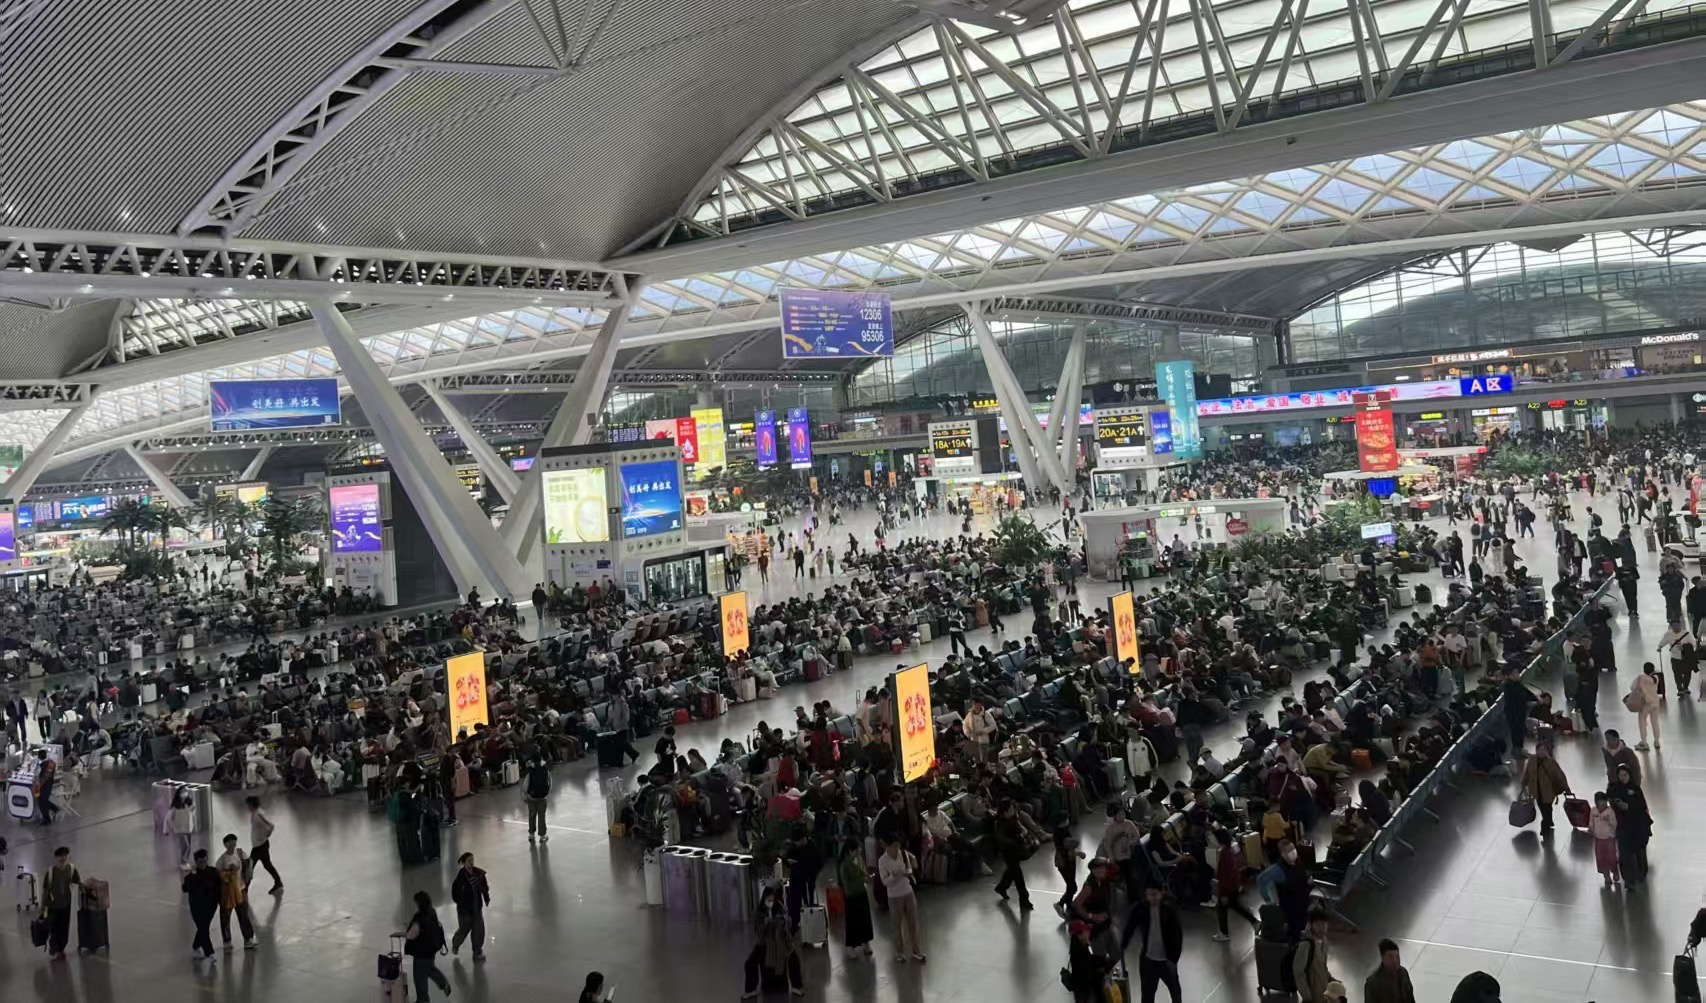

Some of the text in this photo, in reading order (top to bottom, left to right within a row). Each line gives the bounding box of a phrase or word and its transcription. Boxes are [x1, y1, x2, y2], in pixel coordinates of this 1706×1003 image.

[860, 308, 882, 320] 12306
[861, 330, 884, 342] 95306
[1641, 332, 1699, 345] McDonald's
[1470, 377, 1502, 393] A区
[251, 396, 320, 409] 创美好 共出发
[1199, 401, 1221, 415] 公正
[1231, 398, 1255, 412] 法治
[1265, 395, 1290, 408] 爱国
[1300, 392, 1325, 407] 敬业
